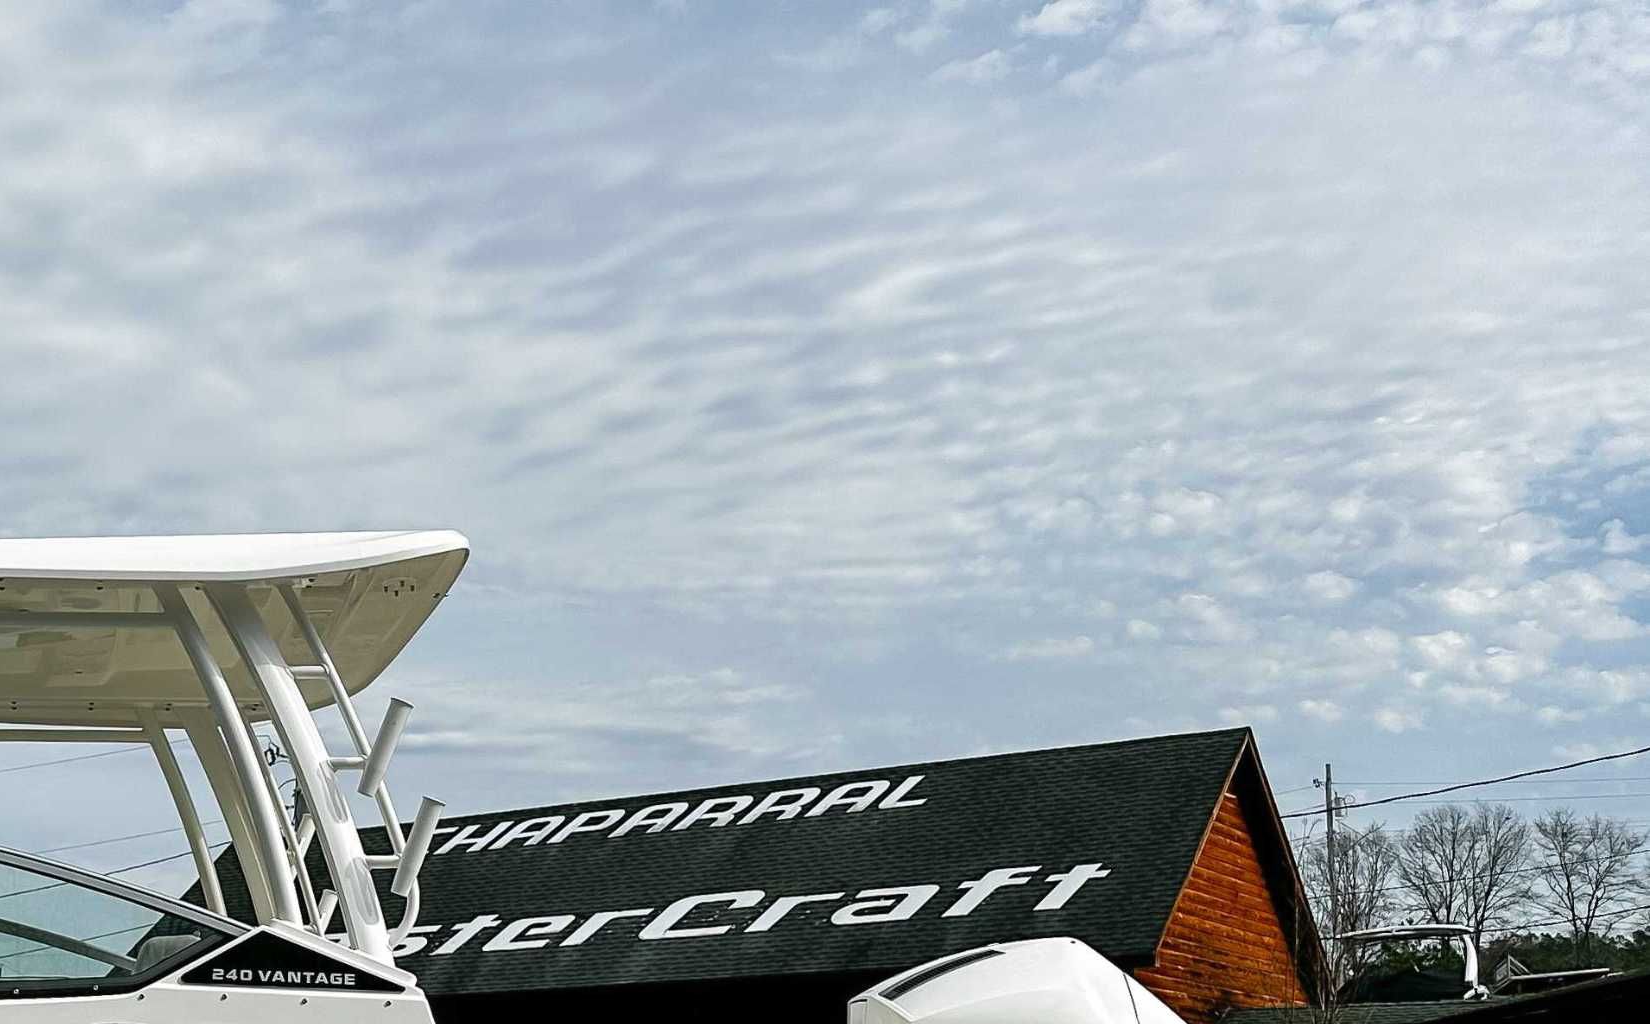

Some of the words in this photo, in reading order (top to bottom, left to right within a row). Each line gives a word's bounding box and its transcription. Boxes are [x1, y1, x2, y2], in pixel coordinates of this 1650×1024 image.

[326, 863, 1112, 958] sterCraft
[212, 968, 252, 981] 240
[258, 970, 356, 985] VANTAGE
